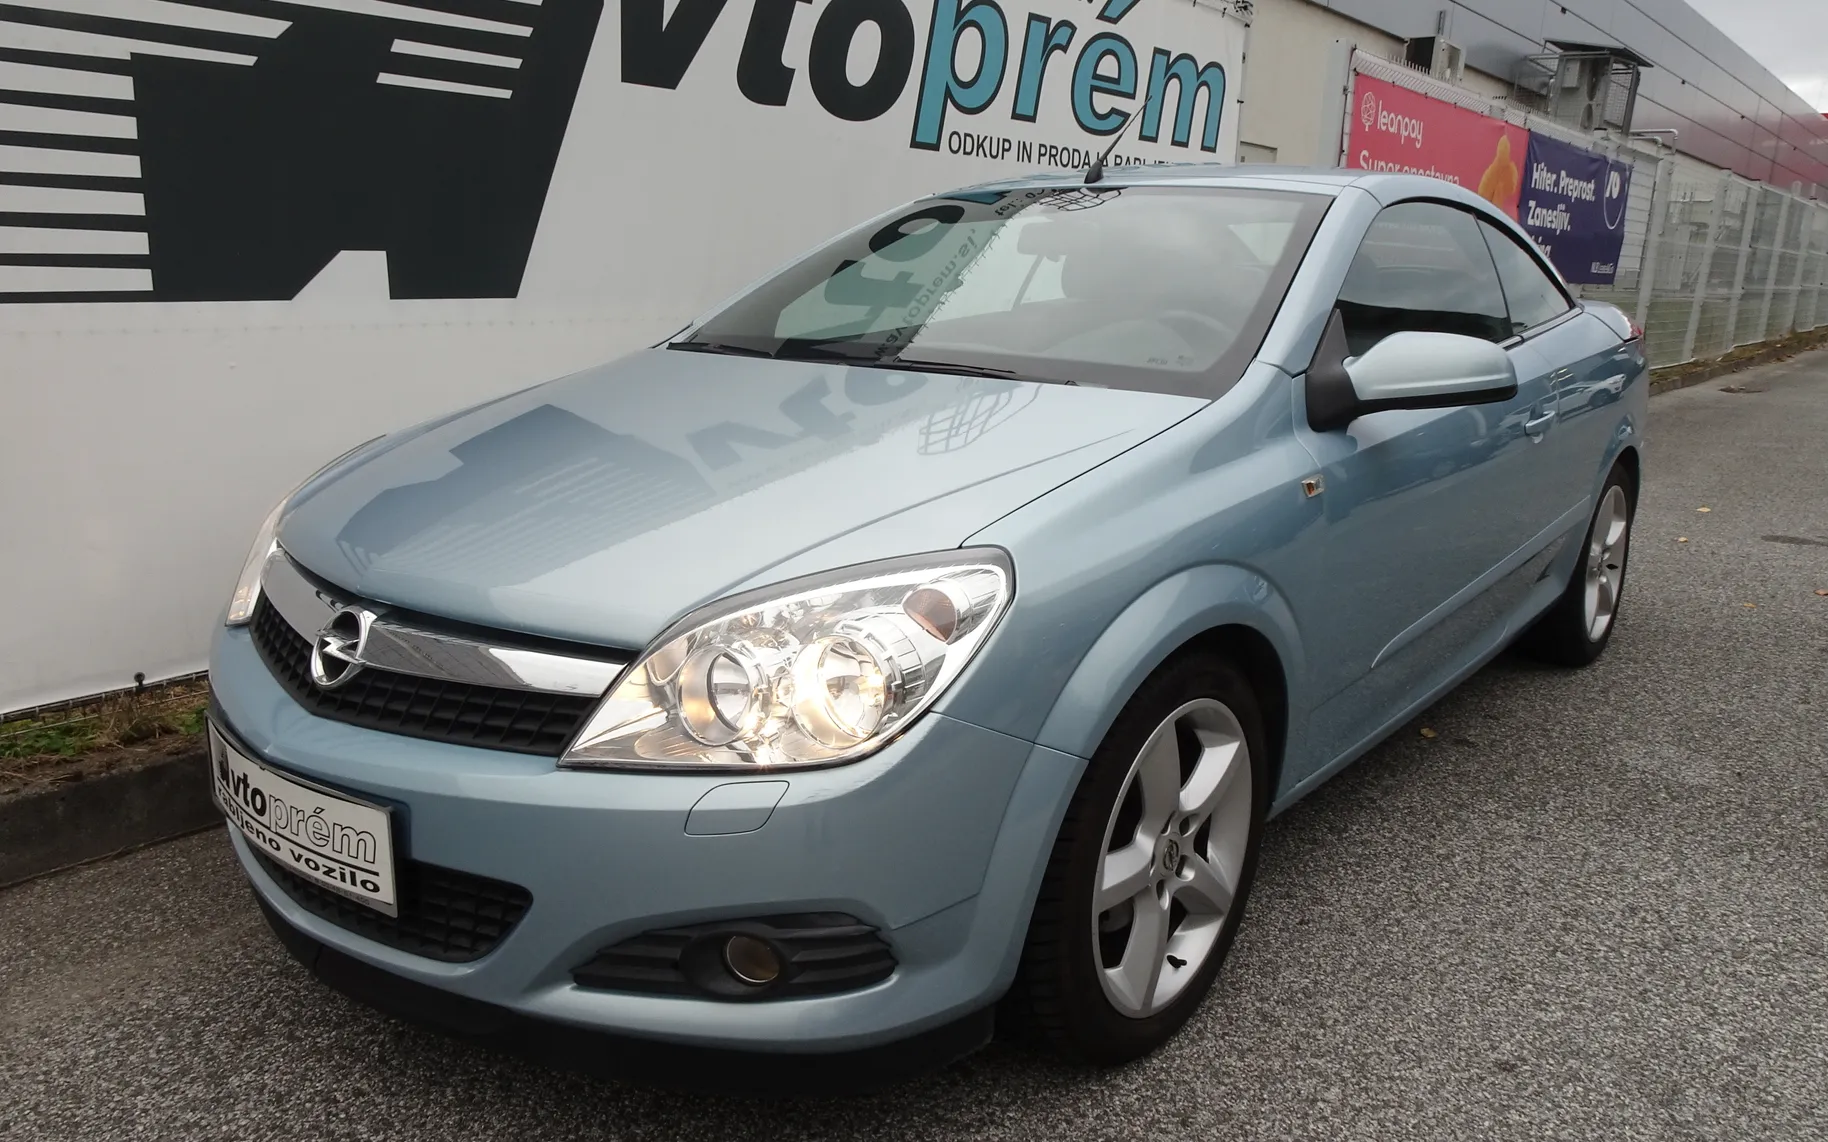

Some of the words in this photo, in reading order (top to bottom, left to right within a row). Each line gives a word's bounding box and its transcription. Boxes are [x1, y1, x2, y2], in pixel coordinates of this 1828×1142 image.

[1378, 100, 1423, 148] leanpay
[948, 130, 1012, 160] ODKUP
[1017, 140, 1032, 163] IN
[1532, 163, 1557, 194] Hiter.
[1559, 171, 1595, 202] Preprost.
[1528, 200, 1571, 235] Zanesljiv.
[217, 786, 281, 851] rabljeno
[289, 848, 381, 893] vozilo
